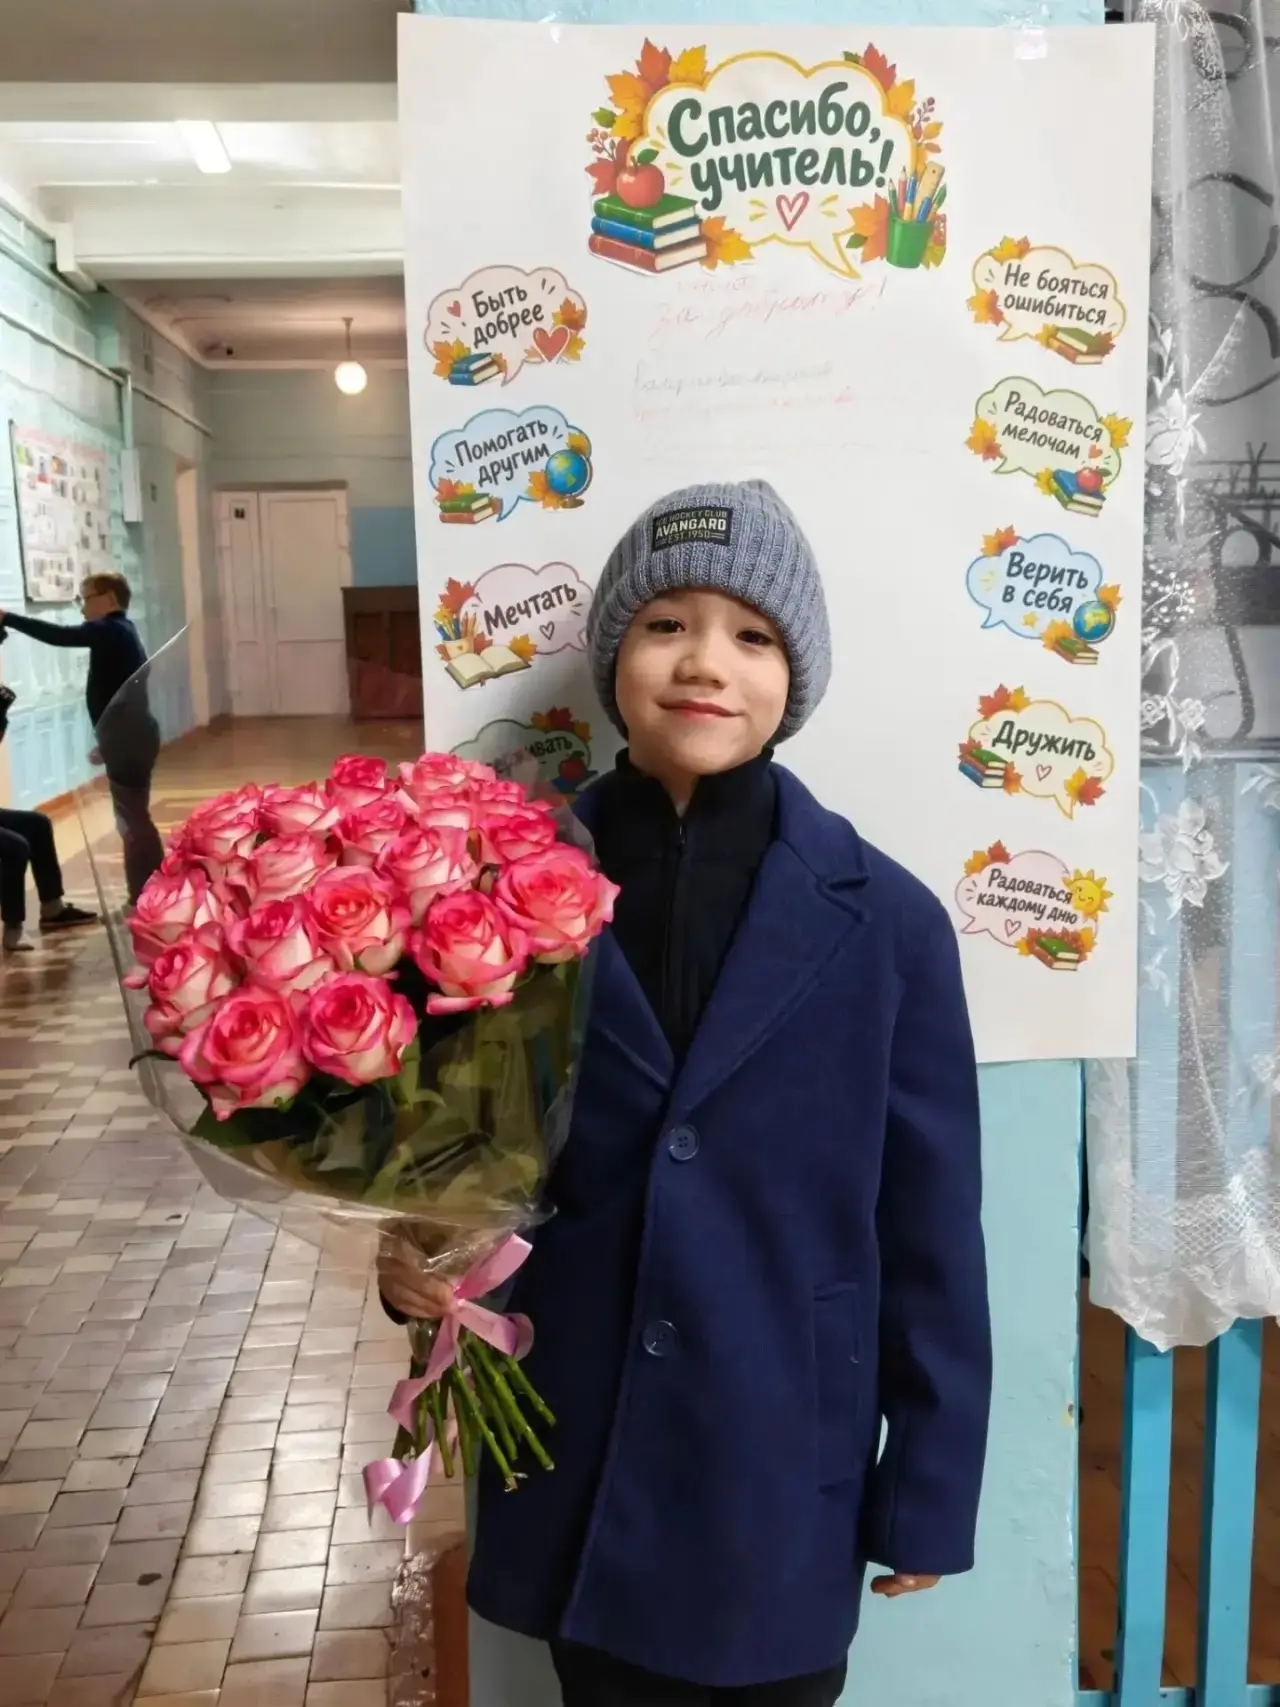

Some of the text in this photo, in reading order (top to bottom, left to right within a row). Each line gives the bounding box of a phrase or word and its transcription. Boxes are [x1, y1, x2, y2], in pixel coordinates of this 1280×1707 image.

[668, 82, 881, 157] Спасибо,
[690, 140, 894, 211] учитель!
[1004, 263, 1109, 300] Не бояться
[471, 286, 528, 318] Быть
[1003, 294, 1107, 325] ошибиться
[473, 304, 544, 349] добрее
[1004, 391, 1103, 443] Радоваться
[454, 419, 548, 466] Помогать
[1002, 423, 1080, 459] мелочам
[478, 443, 550, 487] другим
[656, 518, 727, 540] AVANGARD
[704, 510, 728, 518] CLUB
[1006, 552, 1088, 589] Верить
[484, 583, 577, 636] Мечтать
[1002, 586, 1073, 614] в себя
[992, 720, 1096, 761] Дружить
[988, 868, 1073, 905] Радоваться
[977, 892, 1078, 925] каждому дню
